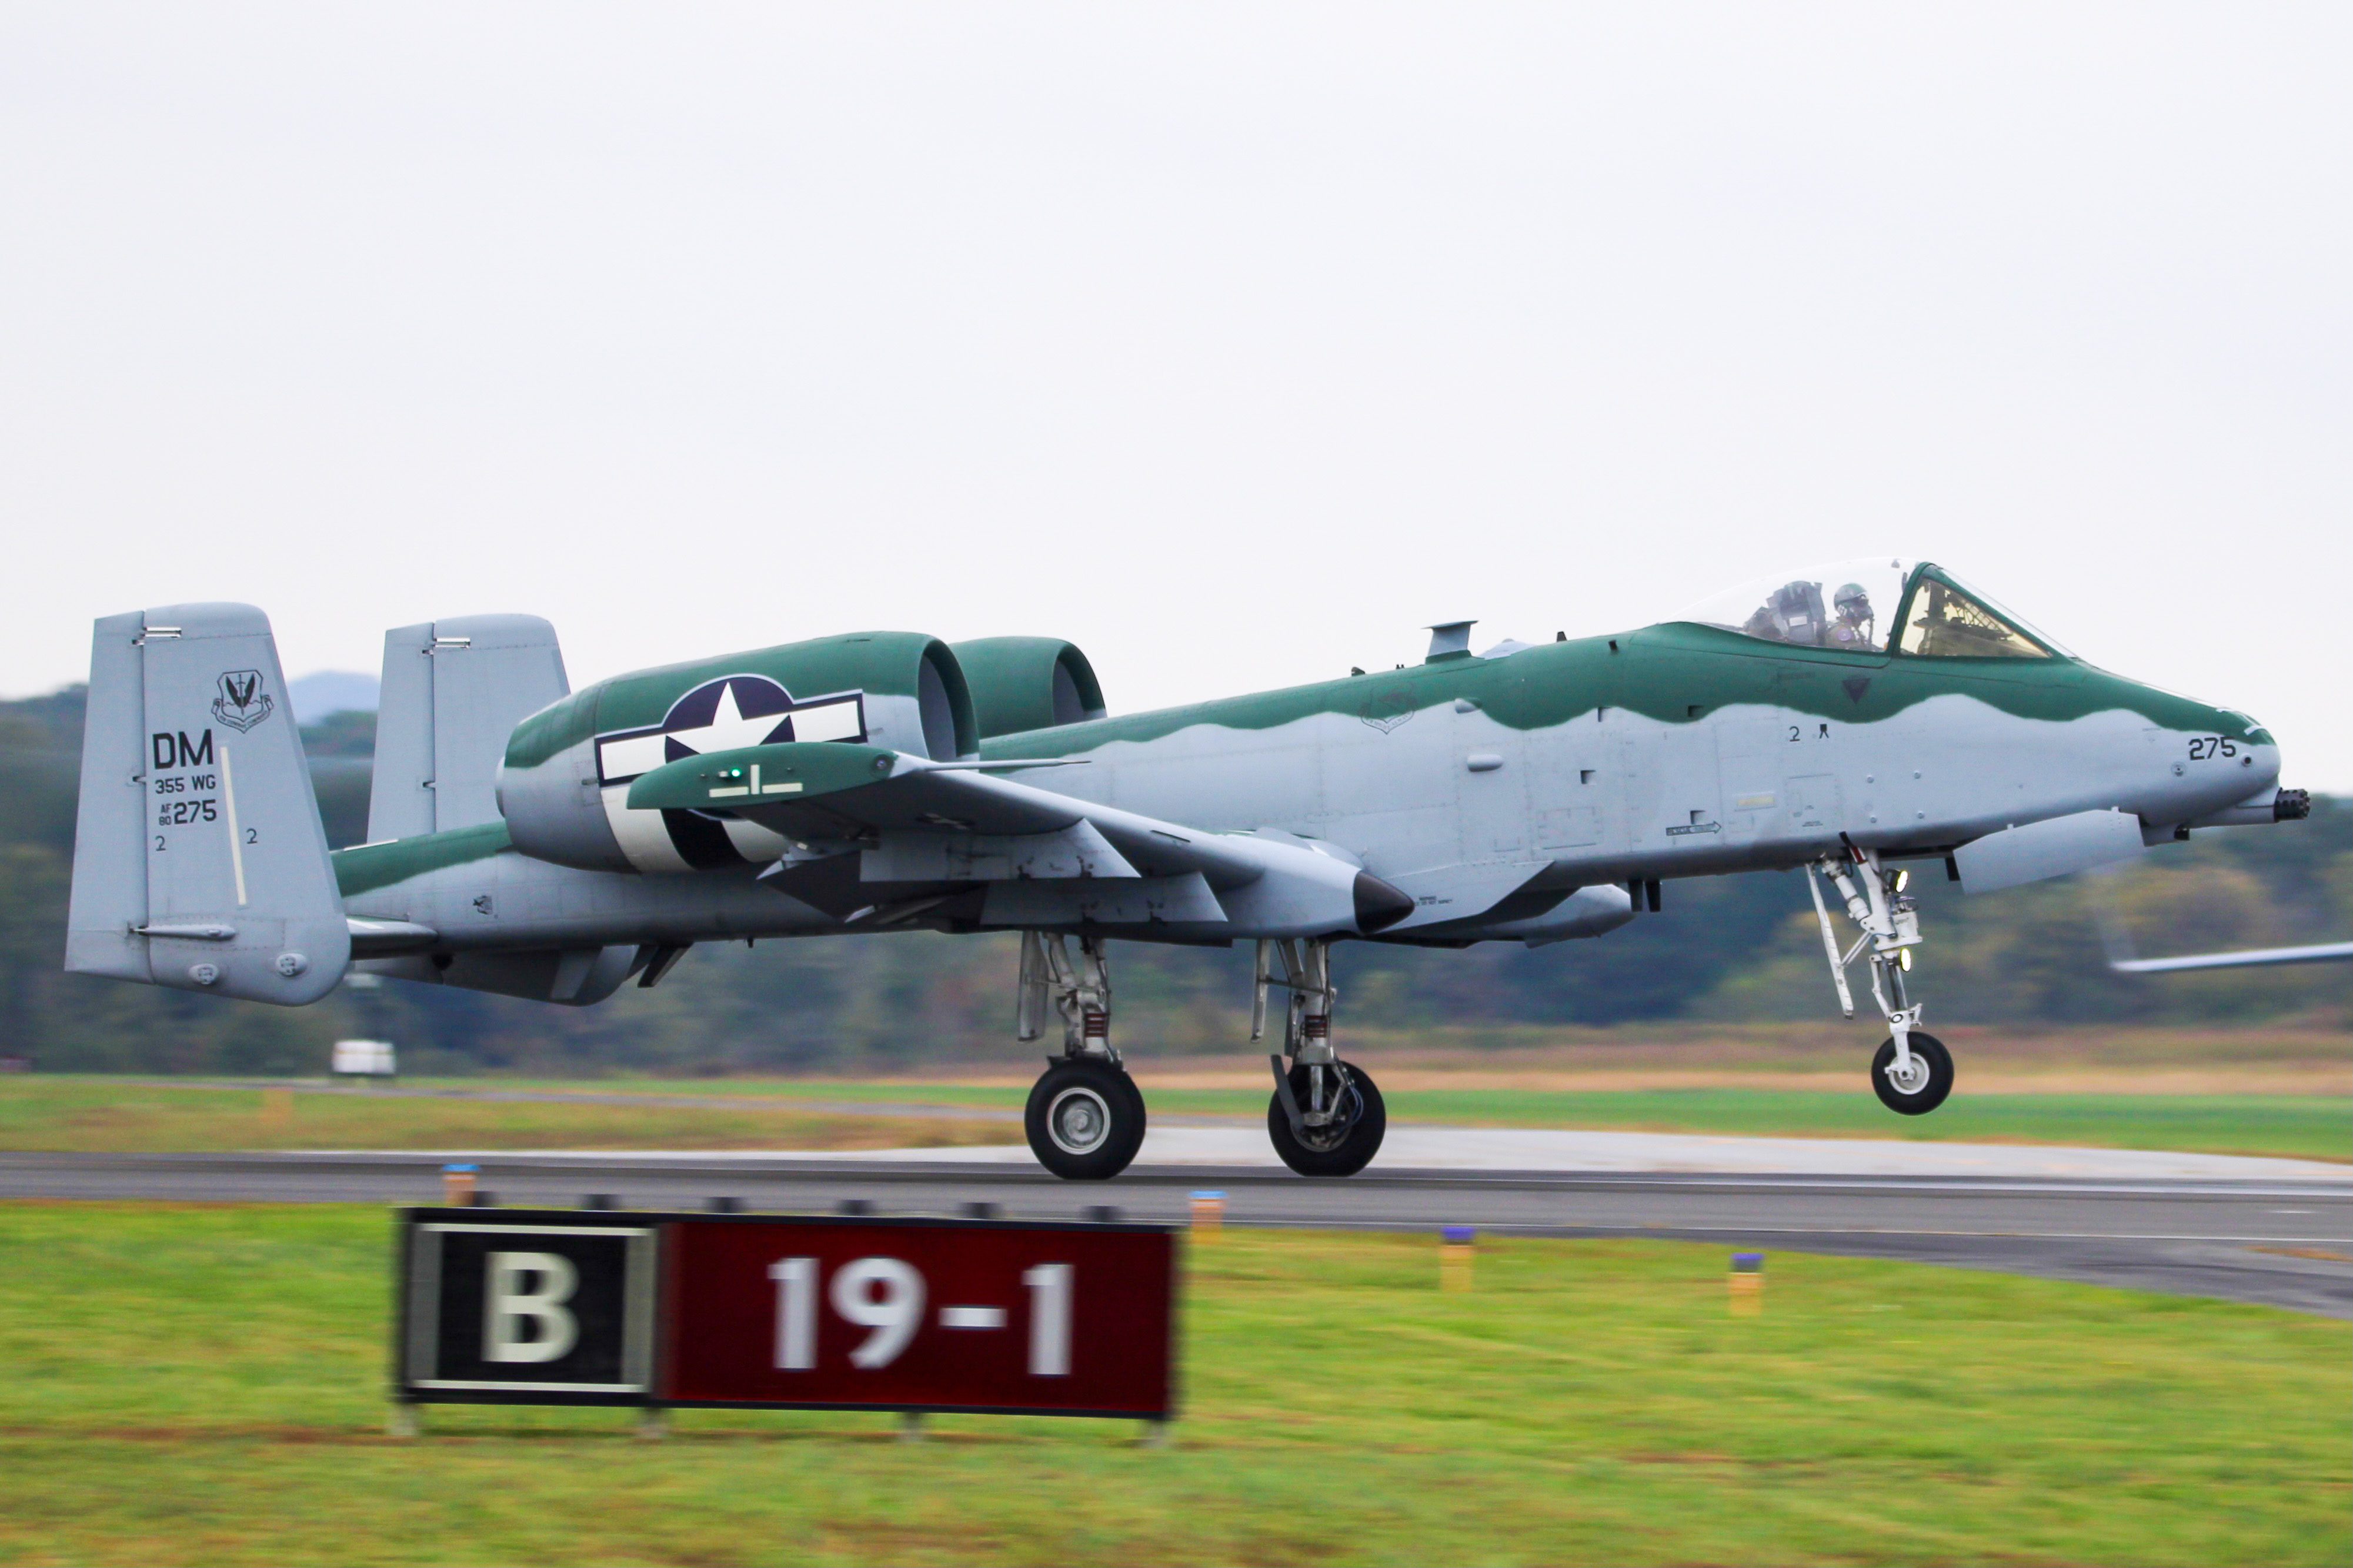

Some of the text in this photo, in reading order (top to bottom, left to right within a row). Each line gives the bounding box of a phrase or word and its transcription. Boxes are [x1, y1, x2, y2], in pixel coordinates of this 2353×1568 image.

[1789, 726, 1800, 741] 2
[153, 729, 213, 770] DM
[2189, 736, 2236, 760] 275
[155, 774, 216, 794] 355 WG
[161, 804, 171, 813] AF
[173, 799, 216, 824] 275
[159, 816, 171, 825] 80
[155, 835, 166, 851] 2
[246, 828, 258, 844] 2
[480, 1252, 580, 1362] B
[767, 1258, 1074, 1375] 19-1
